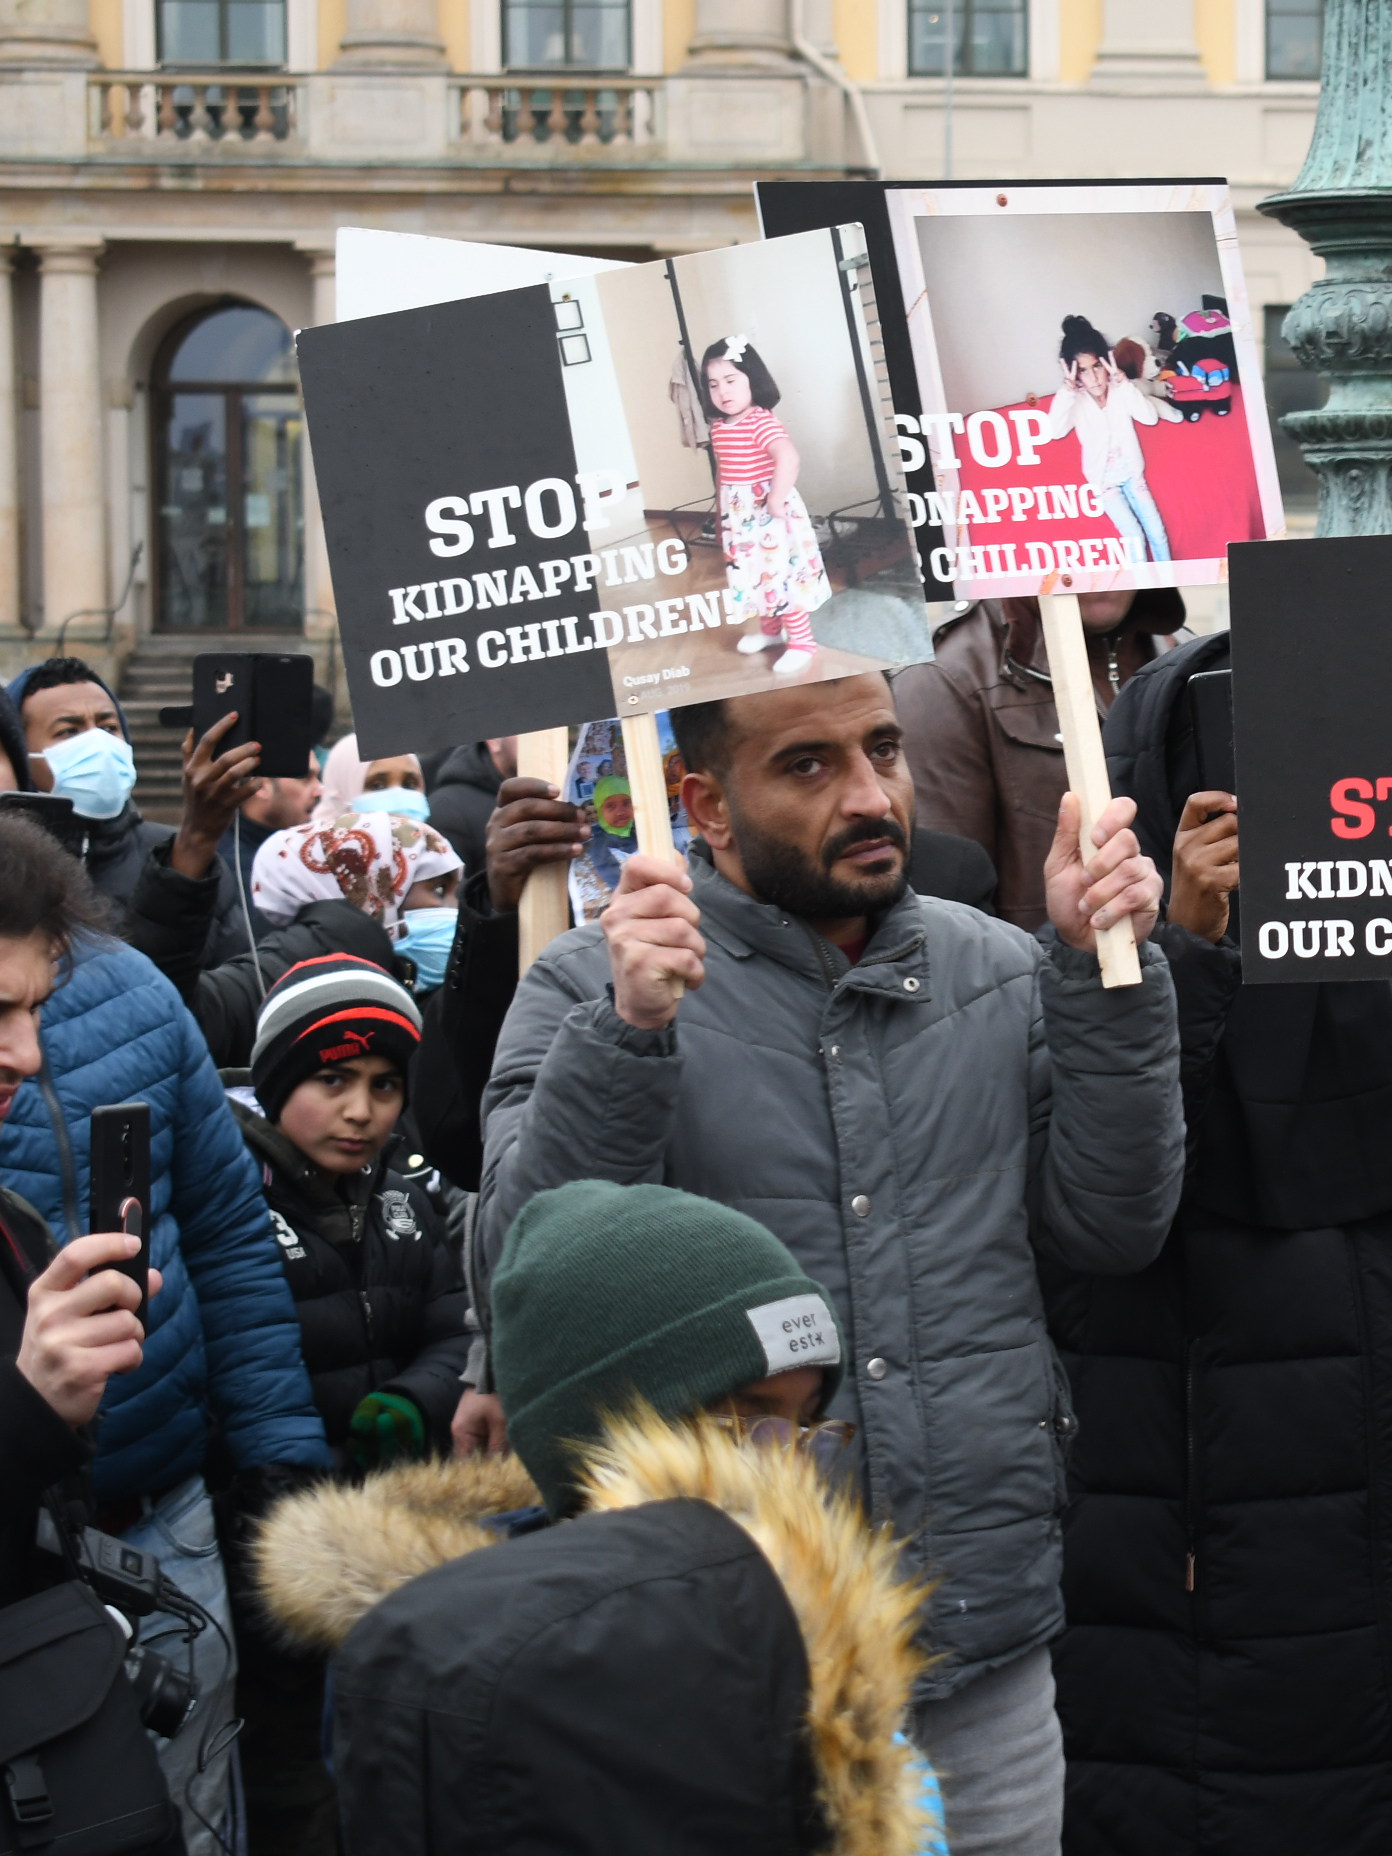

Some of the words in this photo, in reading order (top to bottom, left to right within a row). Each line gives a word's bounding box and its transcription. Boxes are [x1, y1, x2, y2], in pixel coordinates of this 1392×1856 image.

[893, 409, 1053, 473] STOP
[424, 468, 628, 558] STOP
[906, 483, 1106, 528] DNAPPING
[388, 537, 689, 626] KIDNAPPING
[369, 637, 471, 688] OUR
[476, 587, 745, 669] CHILDREN!
[661, 665, 691, 680] Diab
[1257, 918, 1356, 960] OUR
[781, 1313, 817, 1334] ever
